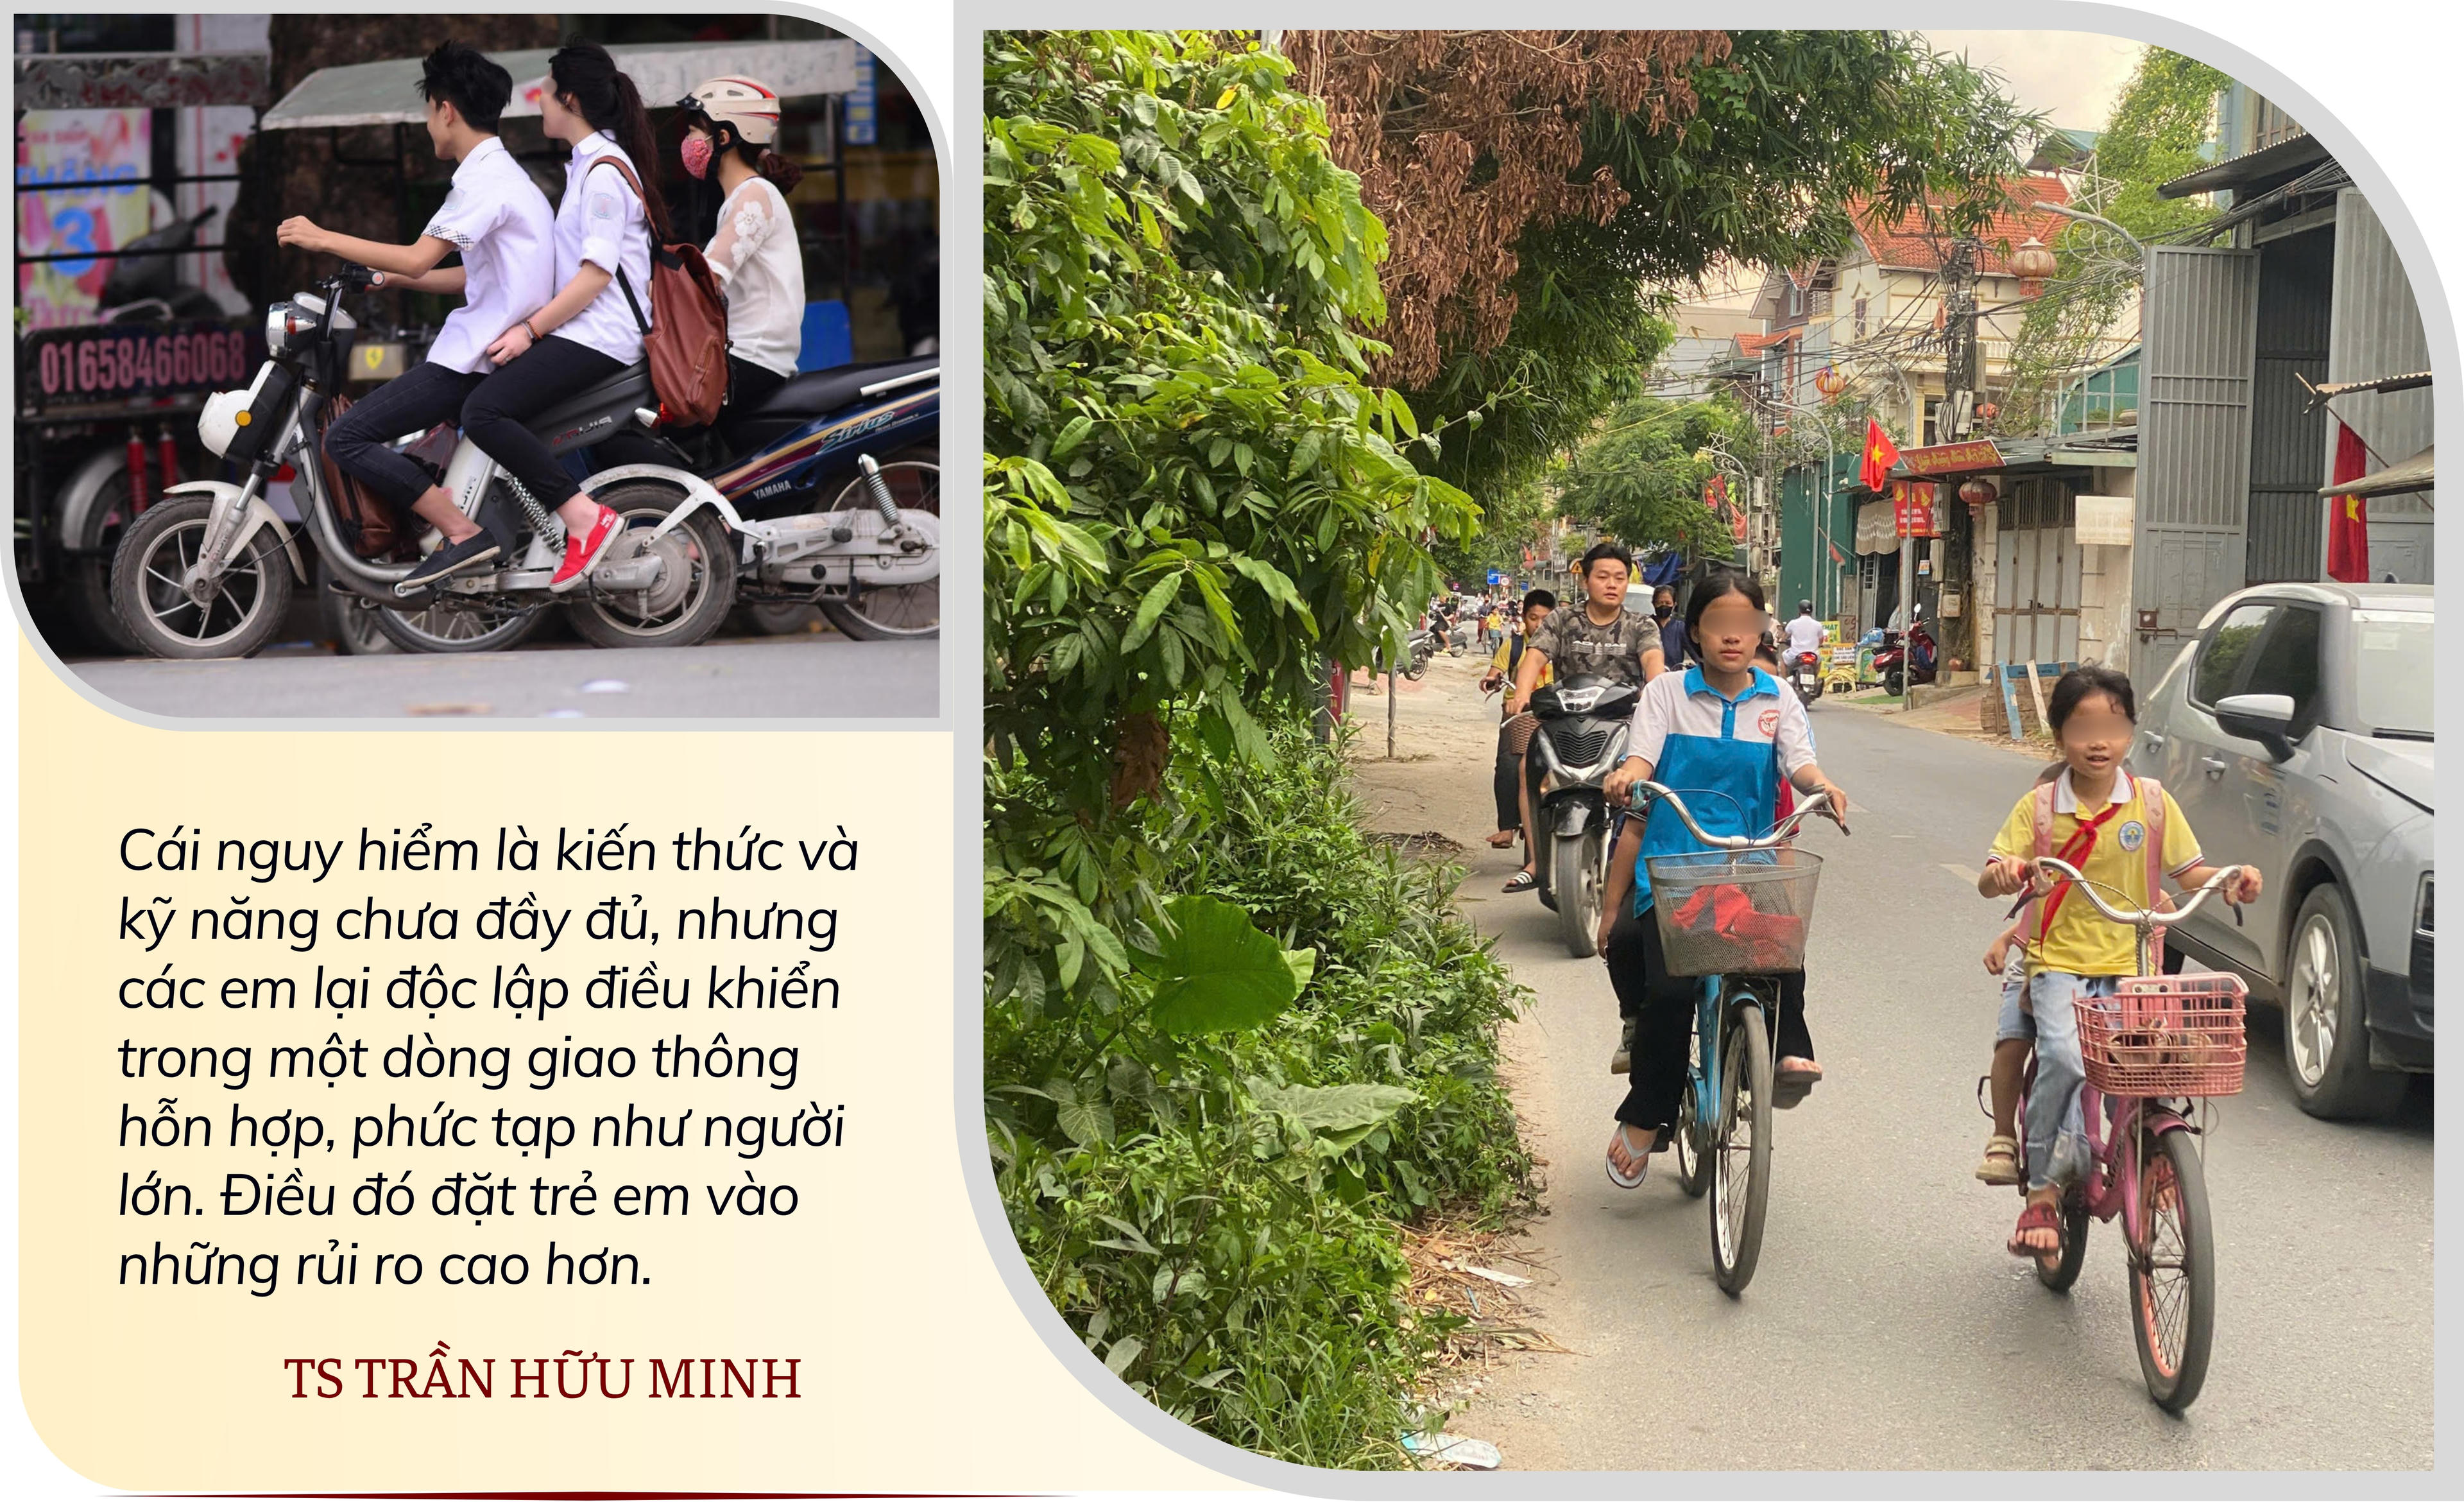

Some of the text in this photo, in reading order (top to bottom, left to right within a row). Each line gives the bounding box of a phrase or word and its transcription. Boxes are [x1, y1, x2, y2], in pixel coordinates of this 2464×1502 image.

[51, 206, 97, 277] 3
[40, 330, 246, 394] 01658466068
[816, 411, 896, 454] Sirius
[753, 479, 792, 501] YAMAHA
